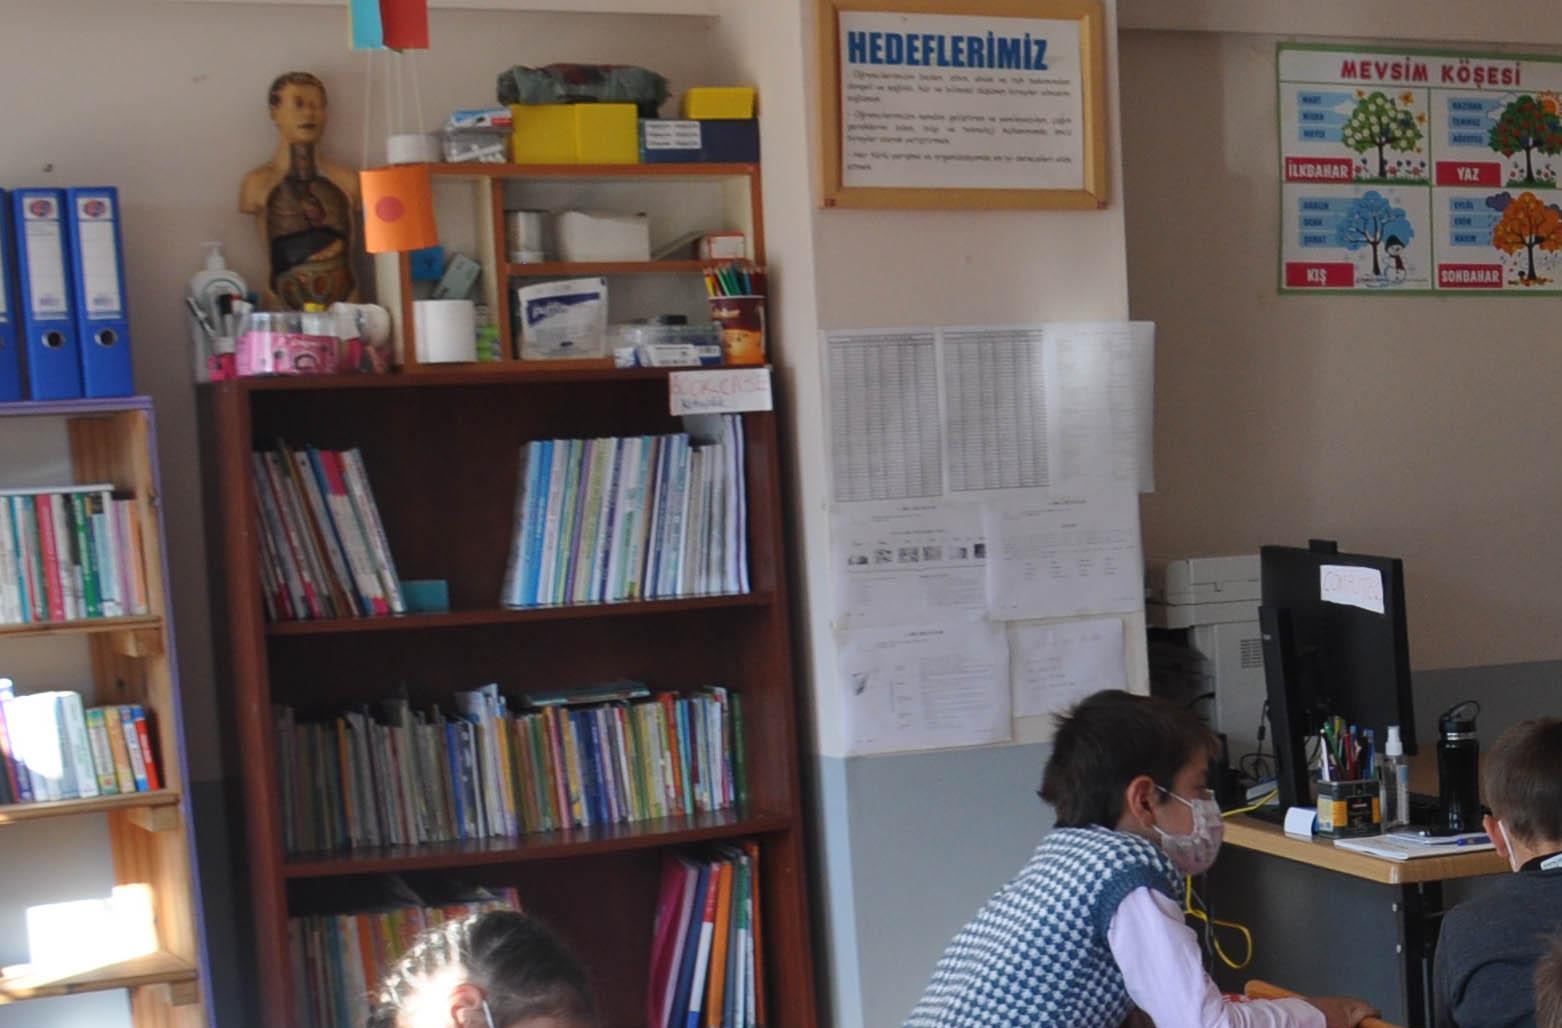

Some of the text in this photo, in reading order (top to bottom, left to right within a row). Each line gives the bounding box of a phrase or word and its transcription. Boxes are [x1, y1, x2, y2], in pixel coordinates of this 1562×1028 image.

[848, 31, 1048, 70] HEDEFLERİMİZ
[1341, 57, 1521, 89] MEVSİM KÖŞESİ
[1457, 167, 1479, 181] YAZ
[1307, 268, 1327, 285] KIŞ
